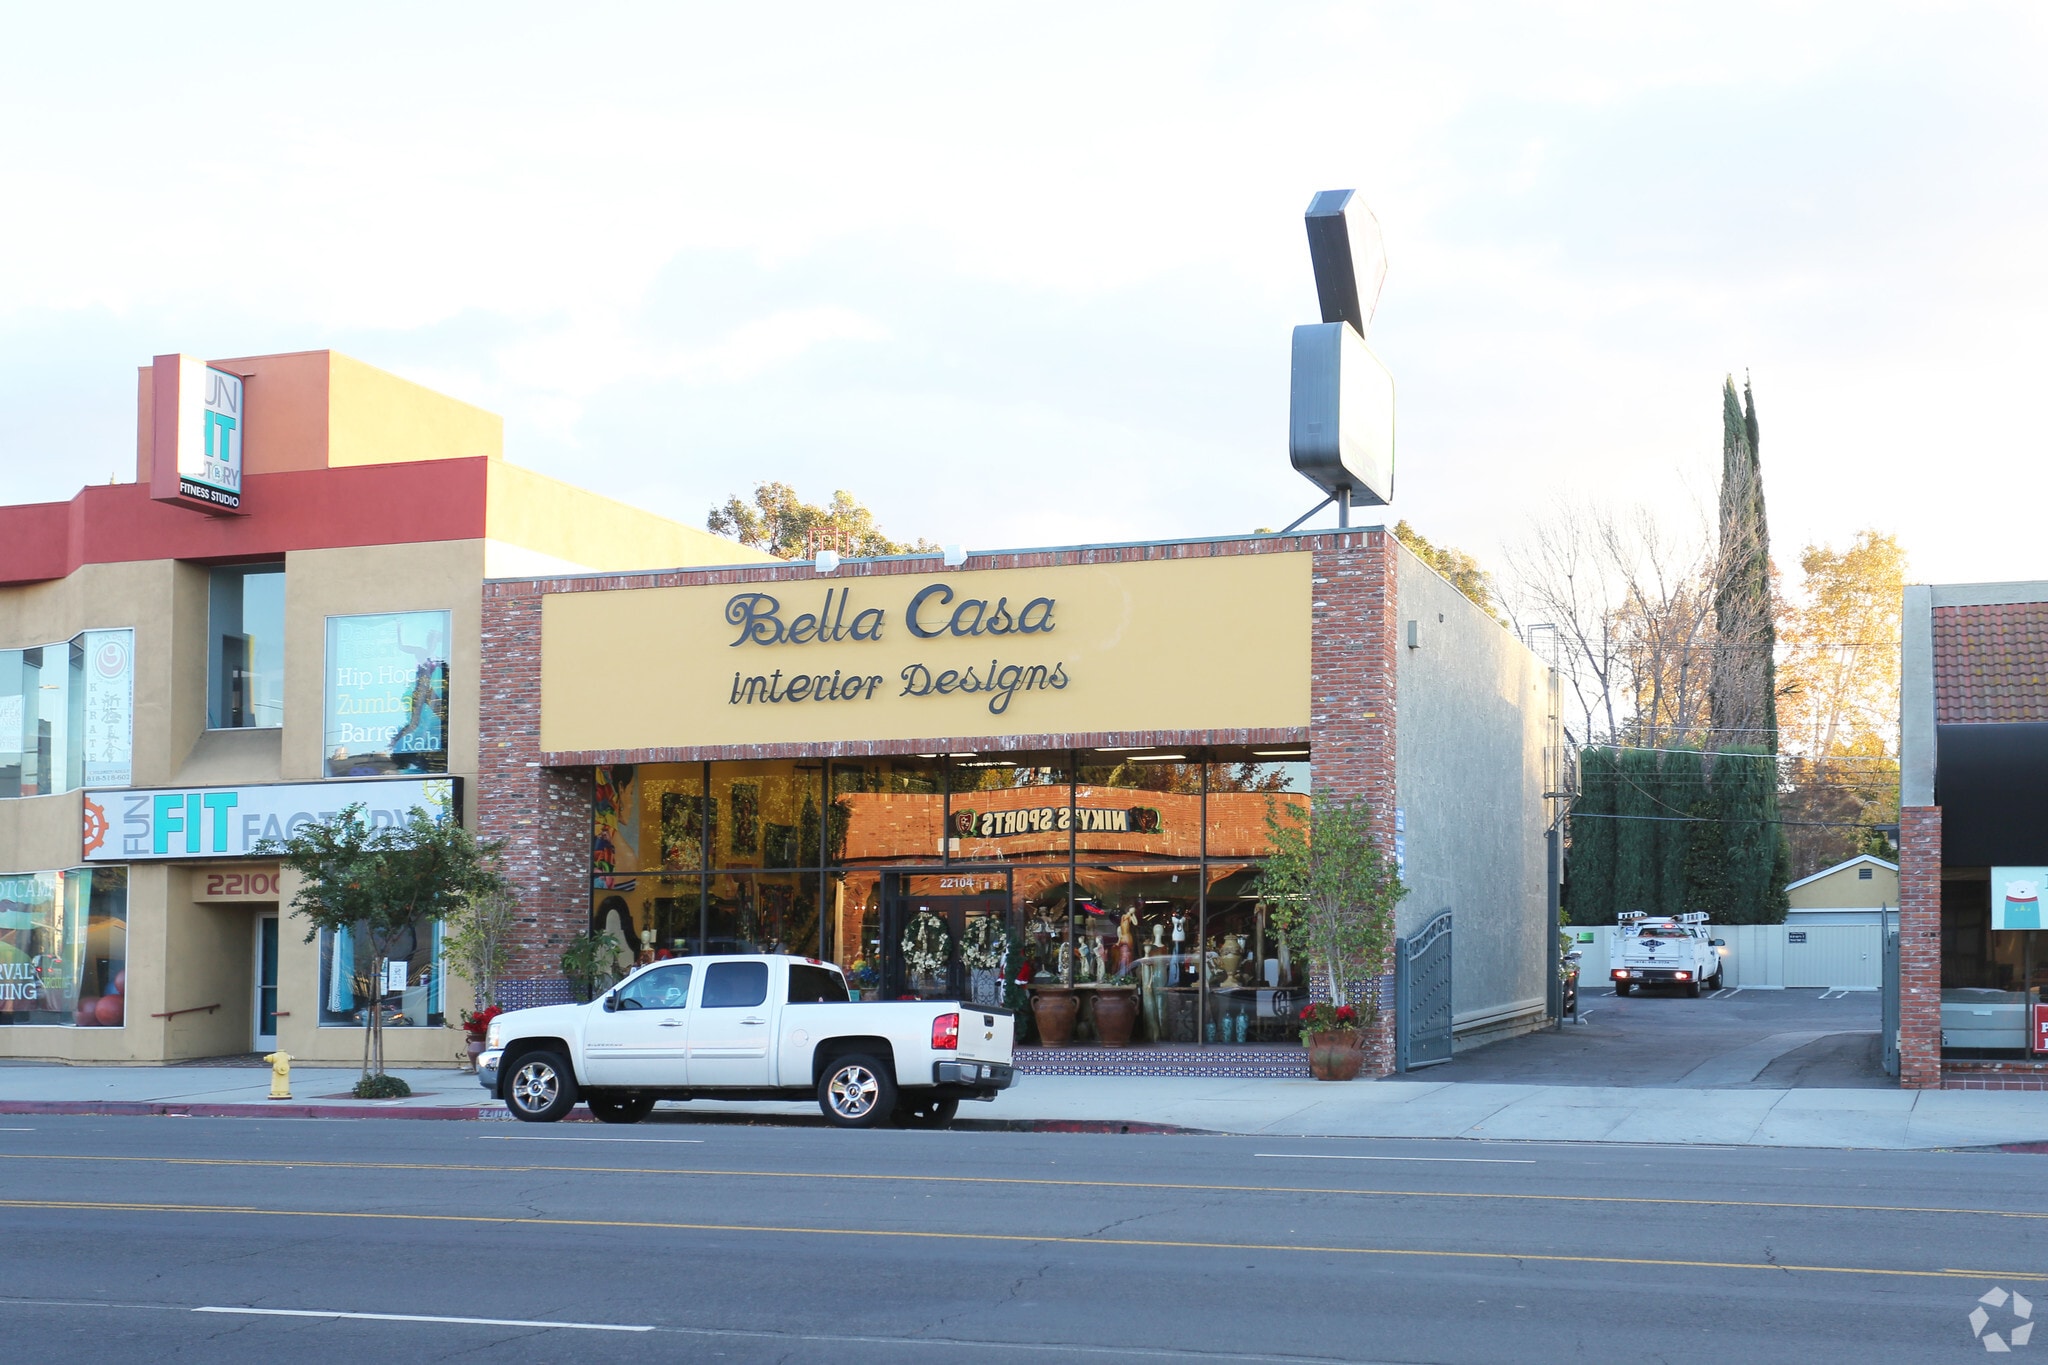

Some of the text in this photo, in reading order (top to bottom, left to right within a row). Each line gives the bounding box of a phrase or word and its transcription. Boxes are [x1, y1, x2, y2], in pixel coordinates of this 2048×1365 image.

[204, 409, 236, 463] IT
[180, 481, 239, 507] FITNESS STUDIO
[725, 583, 1056, 647] Bella Casa
[337, 665, 419, 690] Hip Hop
[728, 659, 1071, 714] interior Designs
[89, 683, 98, 762] KARATE
[337, 691, 413, 715] Zumba
[340, 723, 440, 751] Barre Rah
[123, 795, 150, 855] FUN
[153, 791, 239, 855] FIT
[940, 878, 974, 888] 22104
